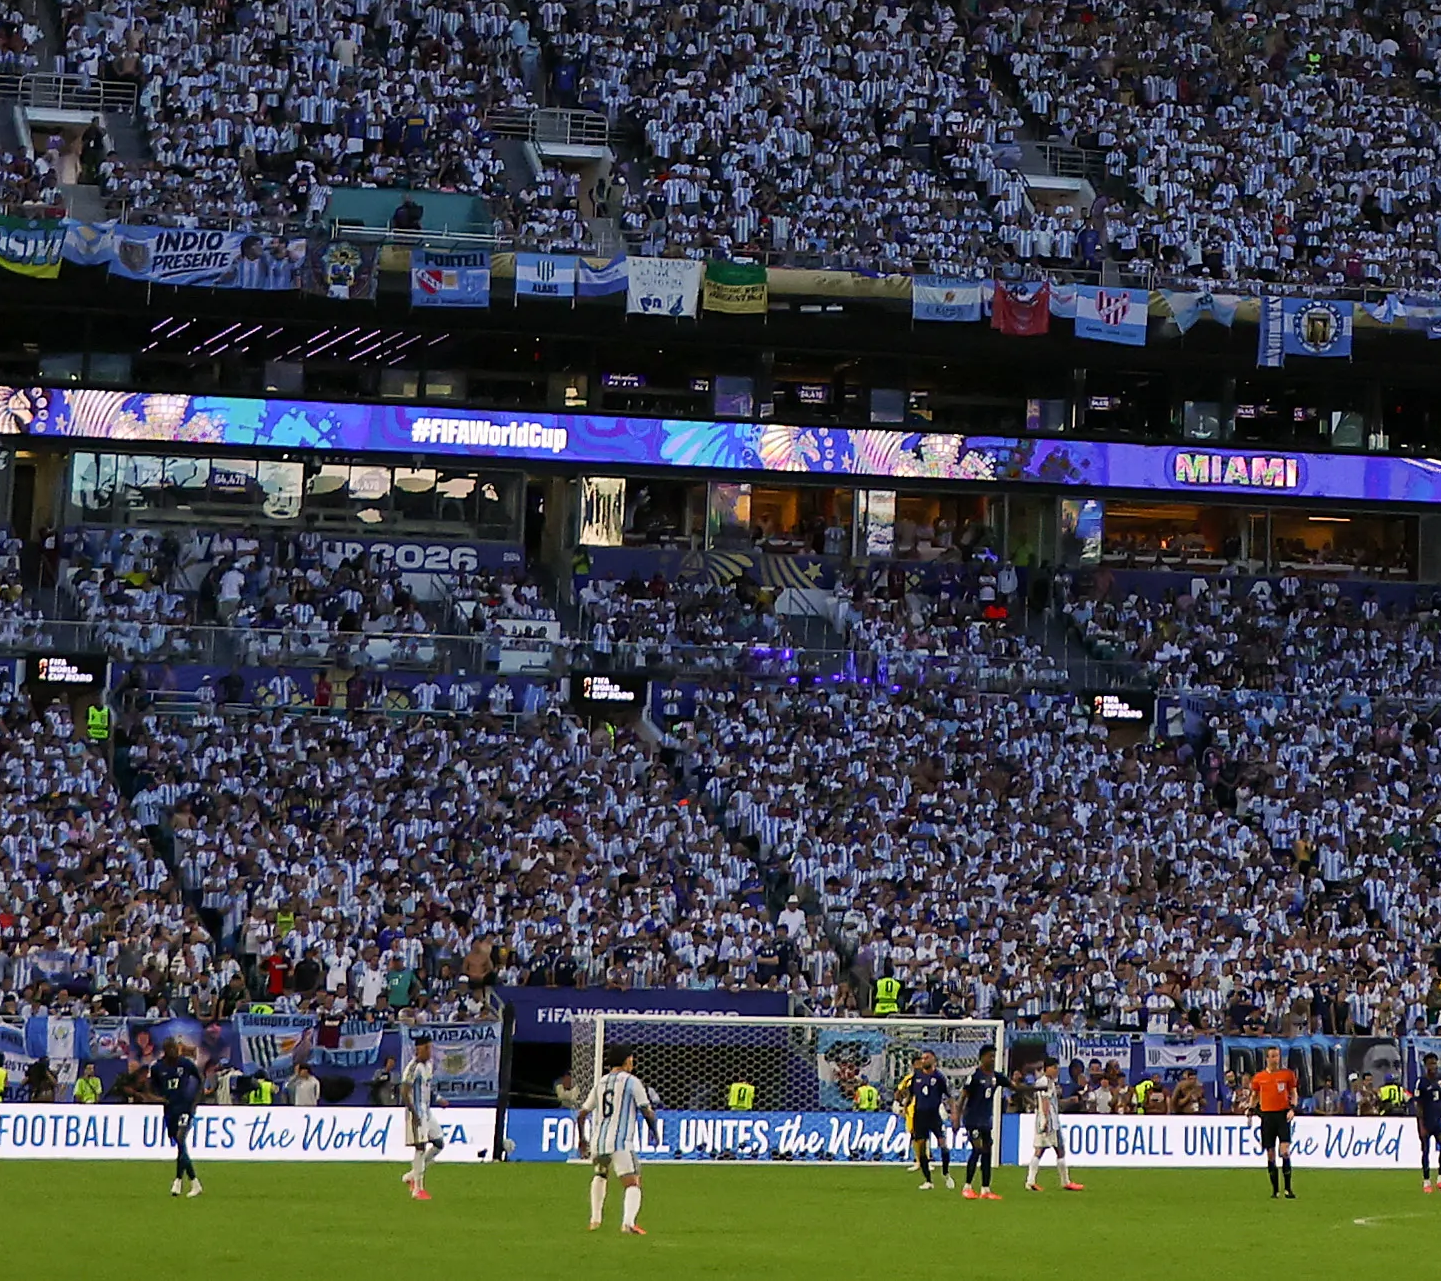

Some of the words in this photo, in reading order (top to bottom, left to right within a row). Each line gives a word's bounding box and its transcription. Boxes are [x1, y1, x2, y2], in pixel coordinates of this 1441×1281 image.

[157, 231, 224, 252] INDIO
[152, 250, 230, 273] PRESENTE
[412, 417, 568, 454] #FIFAWorldCup
[1176, 453, 1298, 488] MIAMI
[601, 1087, 615, 1118] 6
[922, 1083, 930, 1096] 4
[245, 1110, 298, 1153] the
[301, 1112, 391, 1156] World
[679, 1118, 769, 1155] UNITES
[777, 1116, 824, 1157] the
[1324, 1121, 1405, 1159] World
